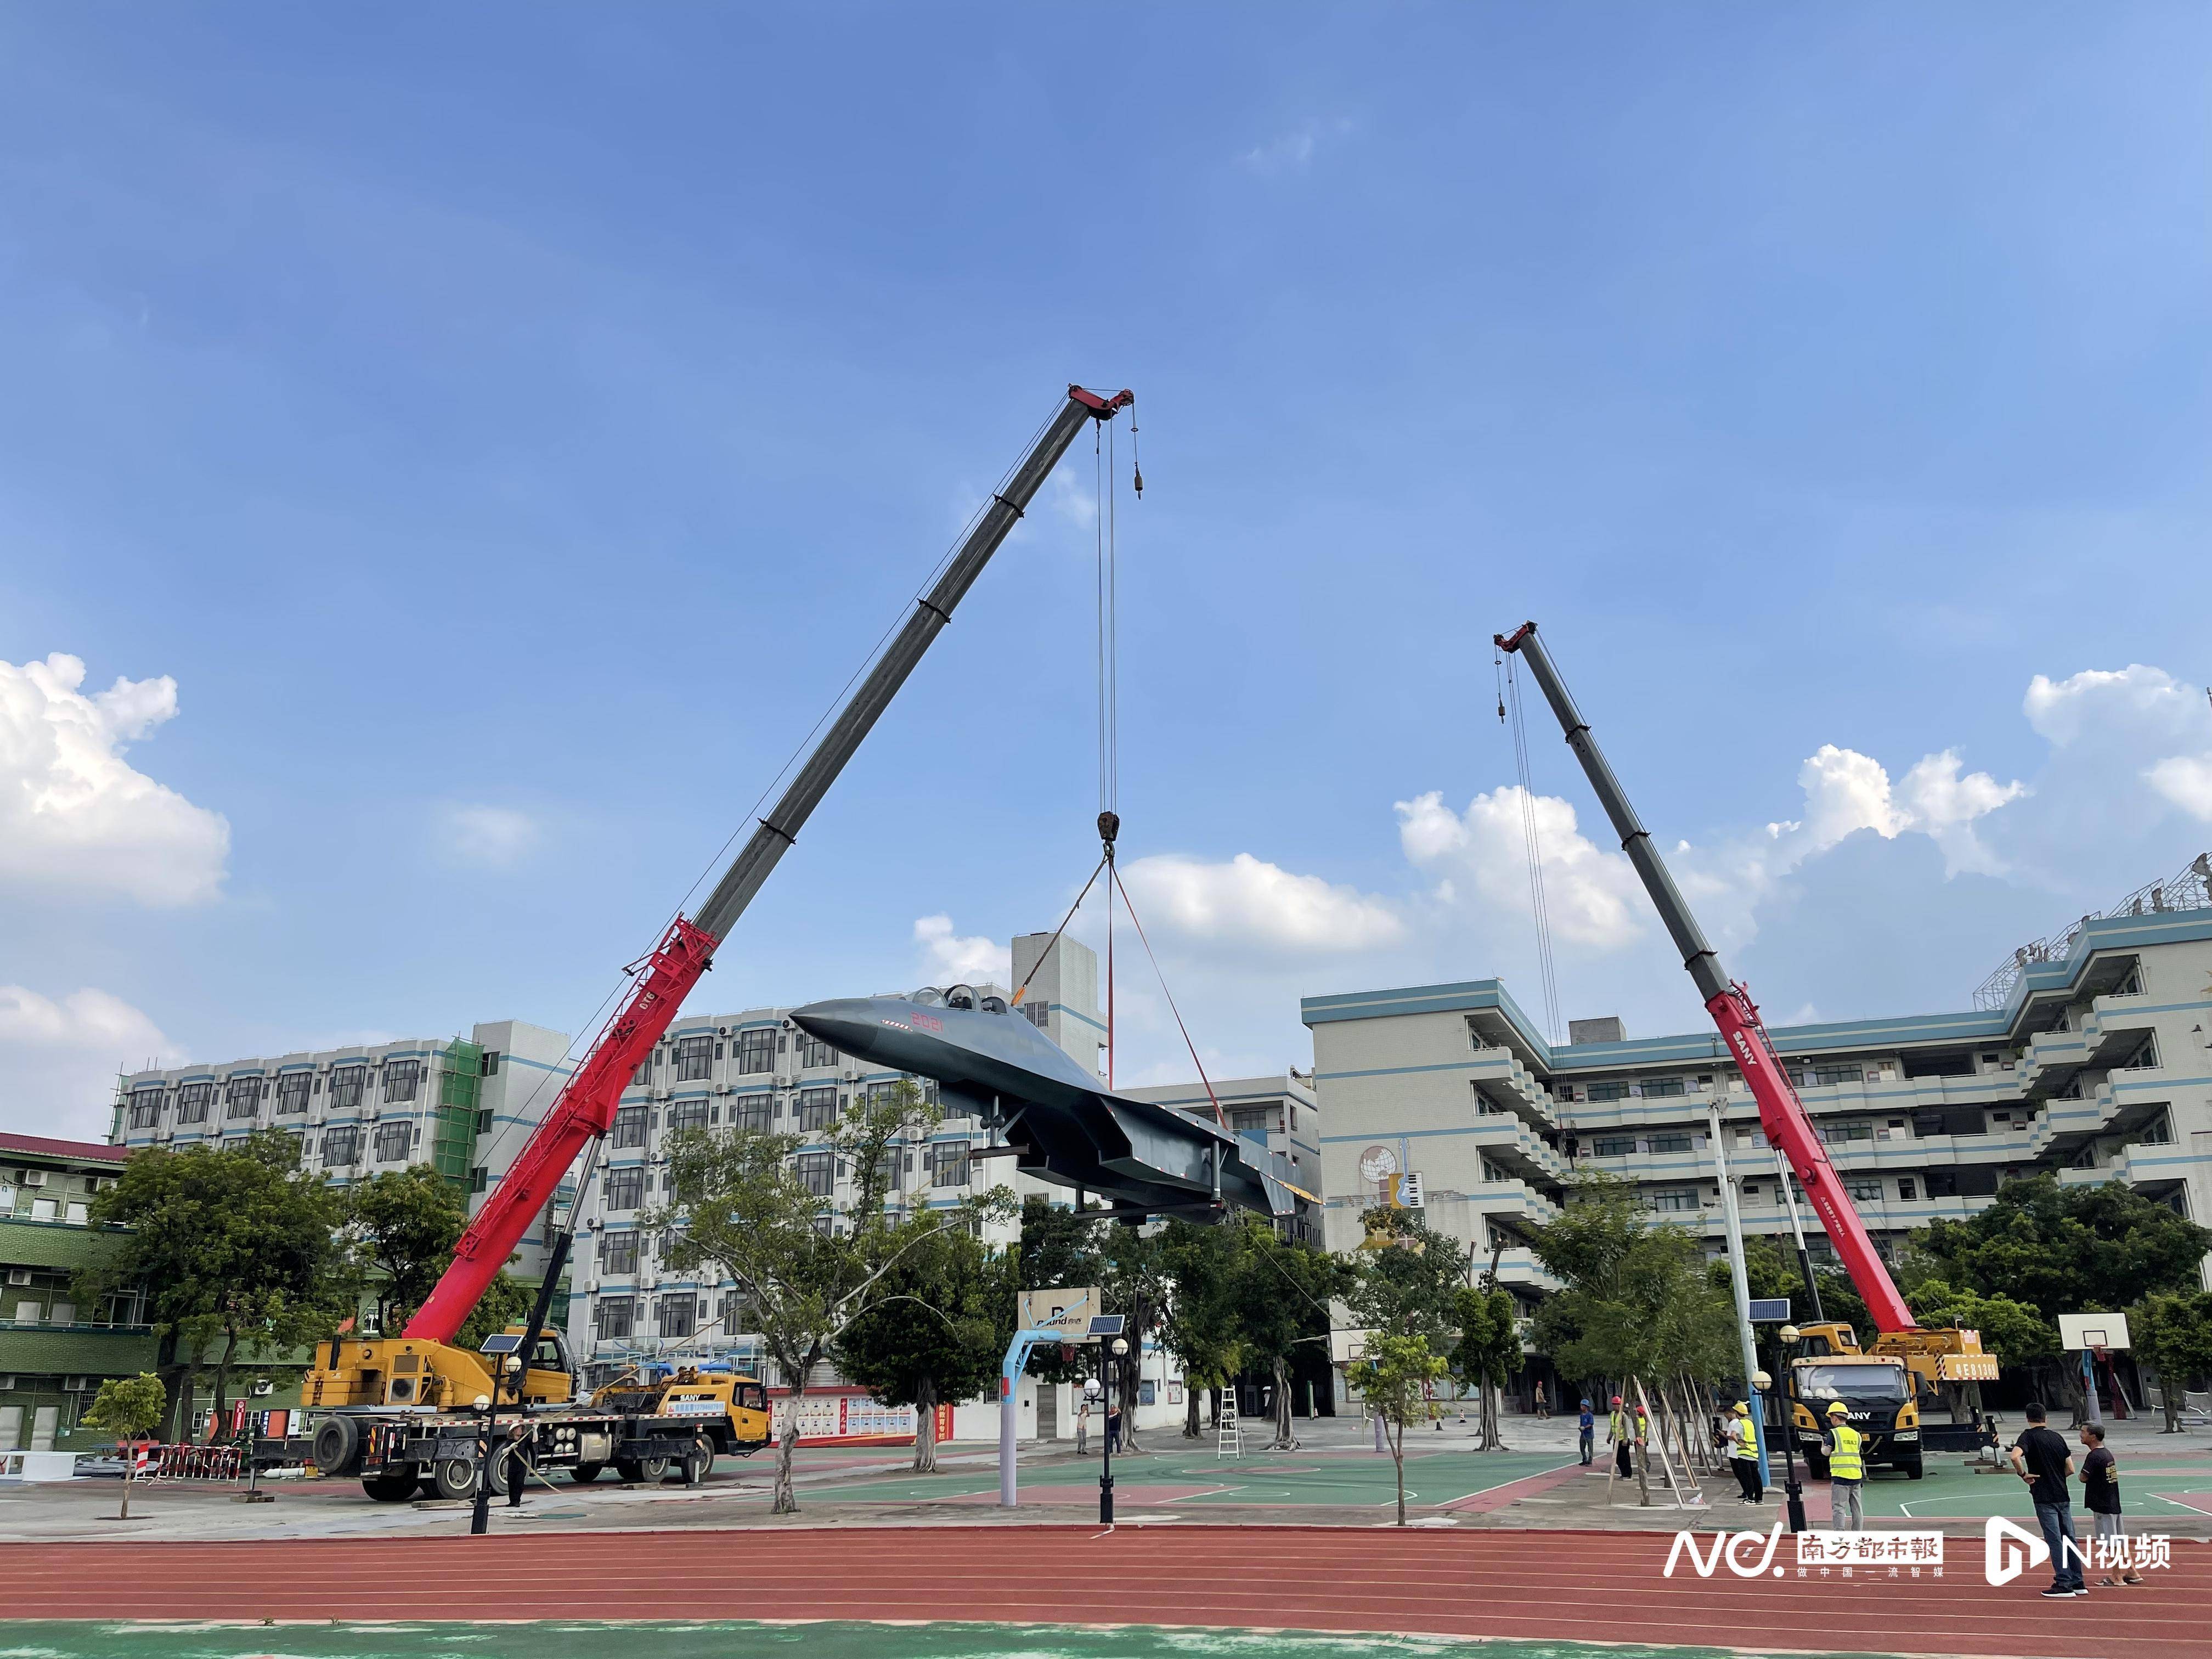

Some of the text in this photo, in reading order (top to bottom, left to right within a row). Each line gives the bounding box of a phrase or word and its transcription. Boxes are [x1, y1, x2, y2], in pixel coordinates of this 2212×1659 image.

[910, 1011, 944, 1032] 2021
[1733, 1031, 1758, 1065] SANY
[1847, 1412, 1871, 1420] ANY
